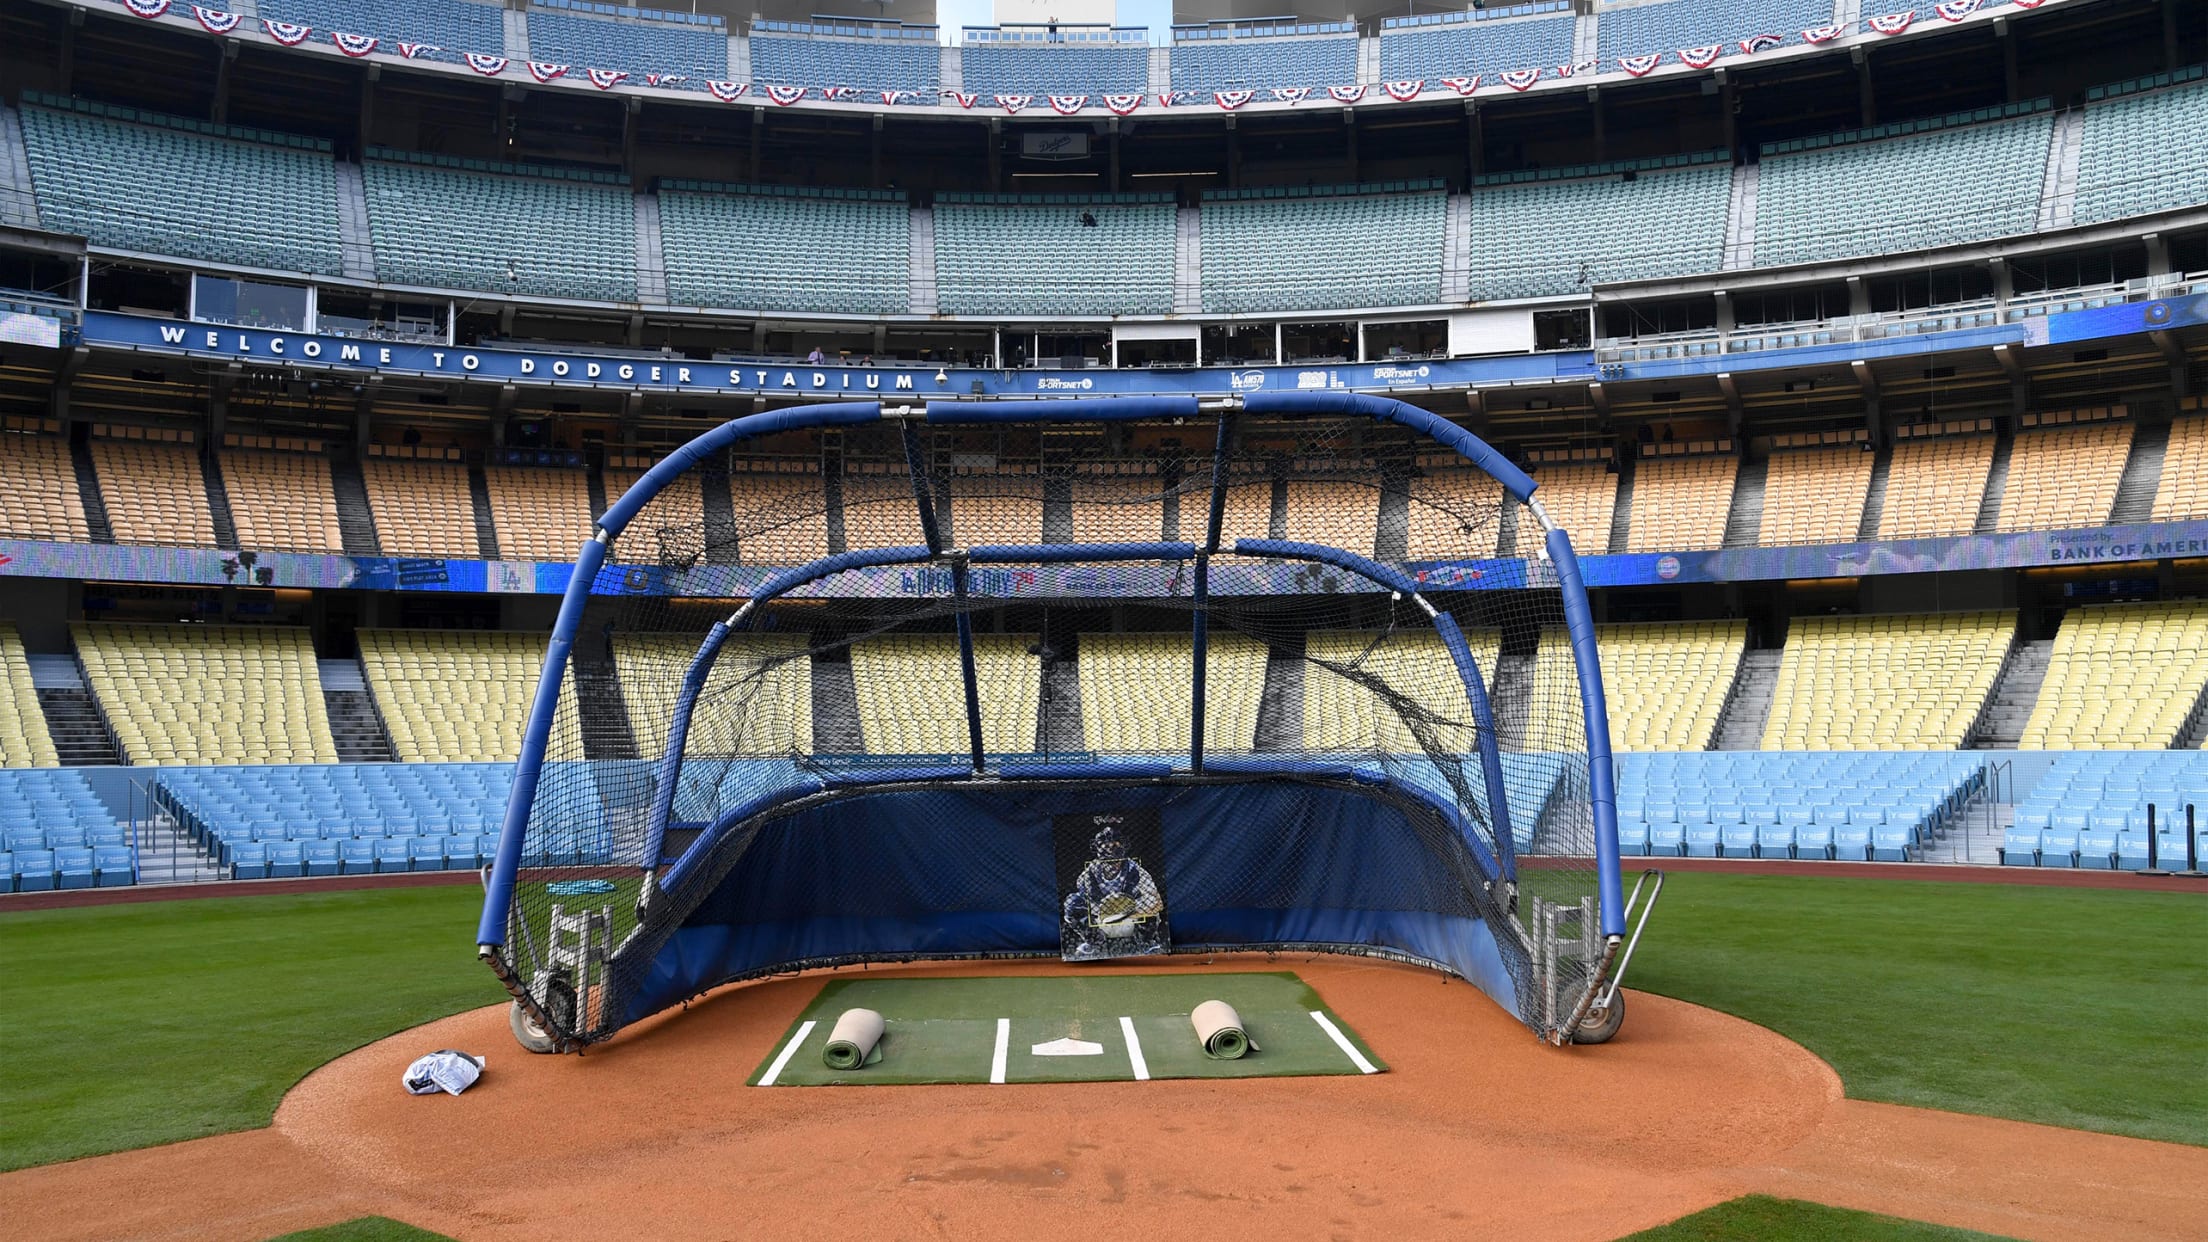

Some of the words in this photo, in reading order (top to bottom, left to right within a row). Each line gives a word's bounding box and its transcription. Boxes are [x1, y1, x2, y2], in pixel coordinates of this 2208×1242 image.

[160, 325, 391, 364] WELCOME
[433, 352, 479, 370] TO
[521, 358, 691, 382] DODGER
[729, 369, 913, 389] STADIUM
[2052, 546, 2105, 560] BANK
[2110, 544, 2136, 556] OF
